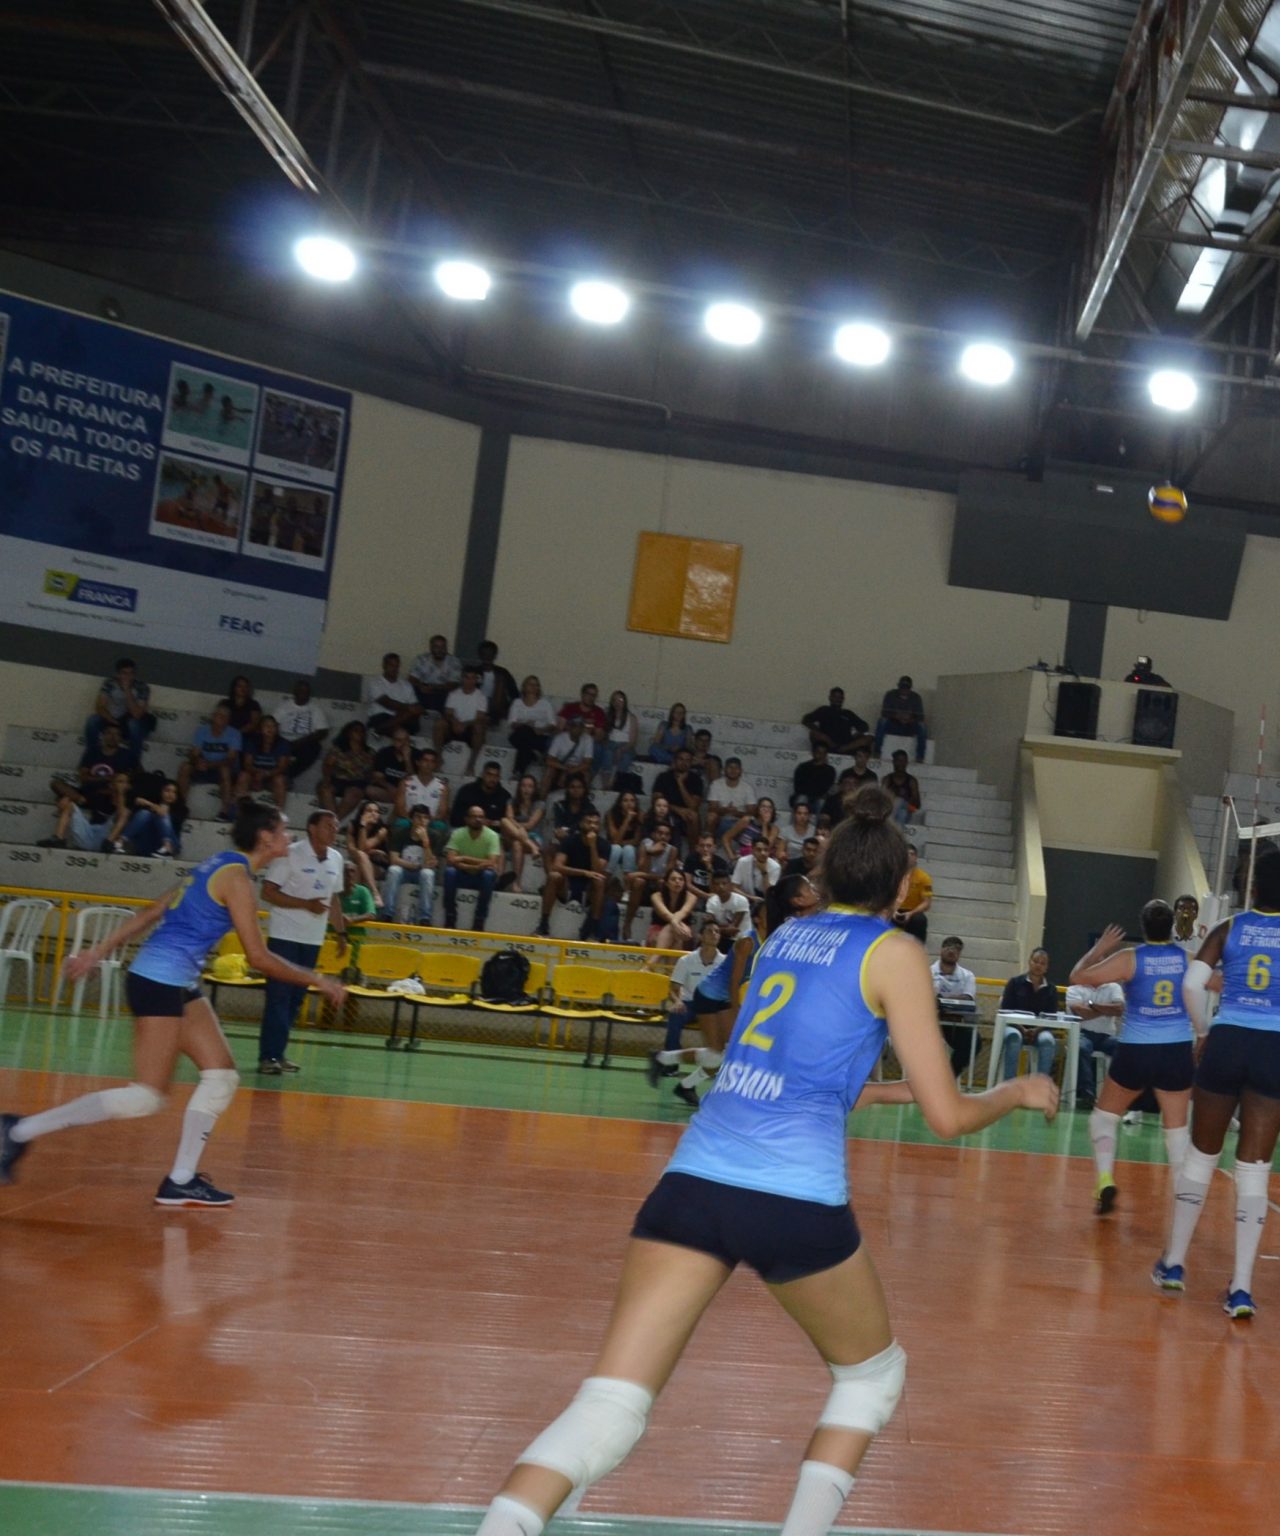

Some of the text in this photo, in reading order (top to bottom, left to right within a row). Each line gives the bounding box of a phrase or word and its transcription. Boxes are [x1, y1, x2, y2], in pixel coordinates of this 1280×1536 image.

[8, 356, 162, 412] A PREFEITURA
[17, 385, 148, 434] DA FRANCA
[0, 407, 156, 460] SAÚDA TODOS
[10, 435, 142, 481] OS ATLETAS
[78, 587, 132, 609] FRANCA
[219, 614, 265, 635] FEAC
[8, 850, 42, 863] 393
[64, 855, 99, 868] 394
[1246, 954, 1272, 991] 6
[739, 971, 797, 1052] 2
[1153, 980, 1174, 1006] 8
